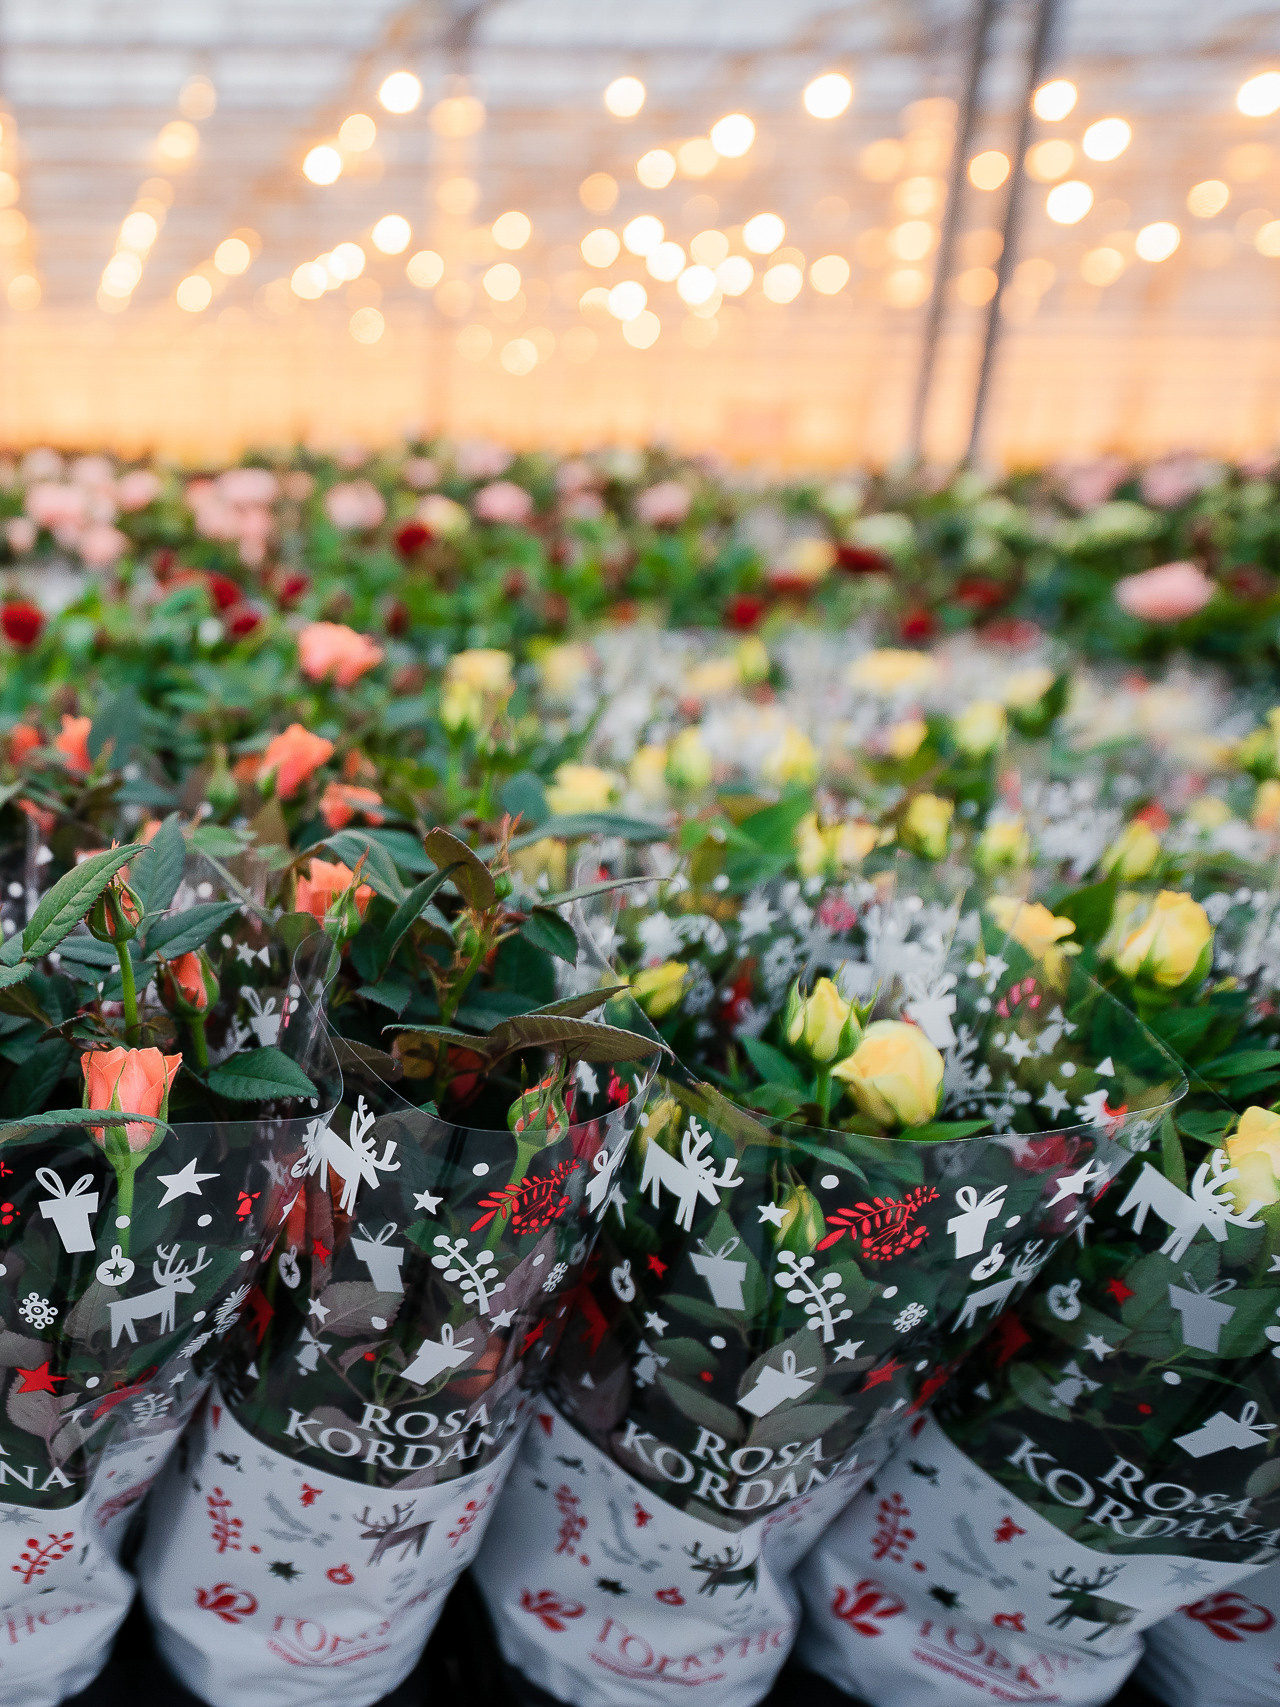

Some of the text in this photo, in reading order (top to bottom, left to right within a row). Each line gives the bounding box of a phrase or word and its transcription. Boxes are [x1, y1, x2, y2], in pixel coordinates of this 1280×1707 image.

[358, 1402, 493, 1439] ROSA
[689, 1426, 826, 1477] ROSA
[1004, 1436, 1280, 1546] KORDANA
[1096, 1454, 1254, 1519] ROSA
